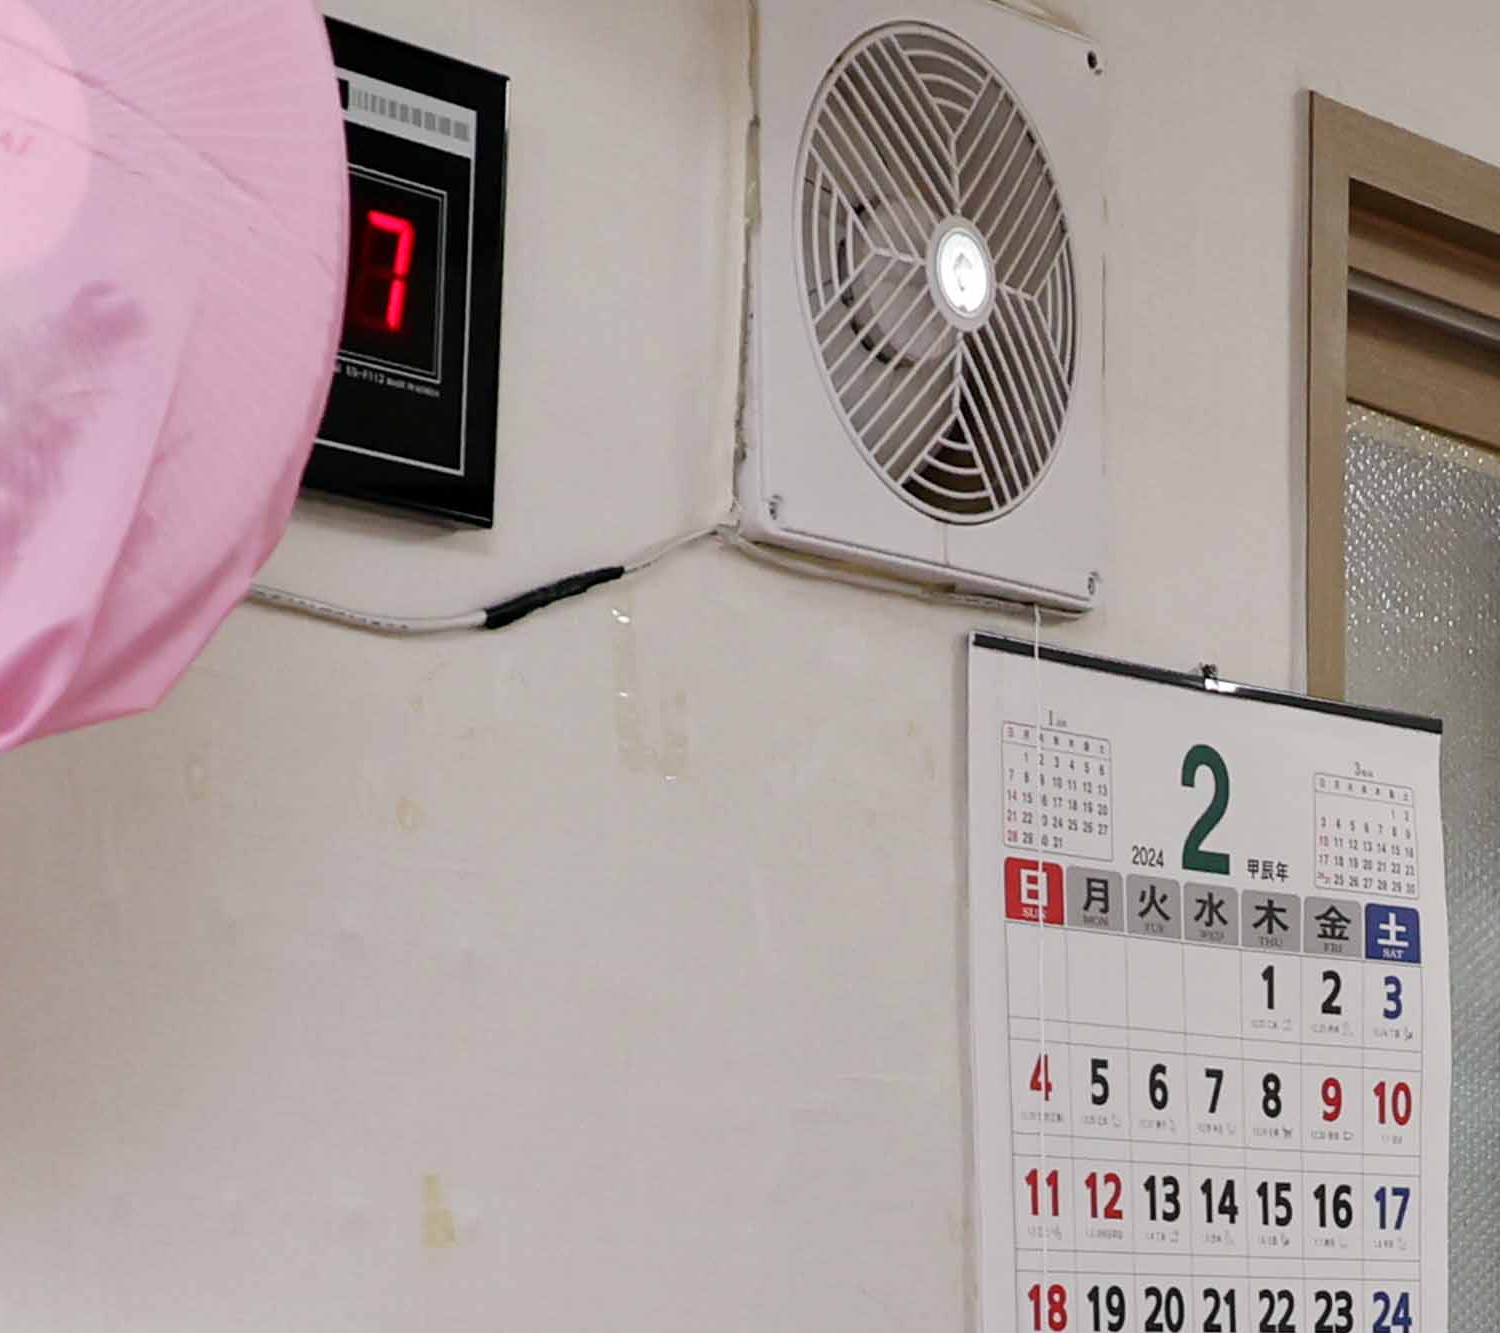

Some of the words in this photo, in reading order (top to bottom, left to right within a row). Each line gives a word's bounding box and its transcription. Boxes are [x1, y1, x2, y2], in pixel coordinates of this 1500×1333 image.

[367, 210, 416, 331] 7
[1181, 744, 1230, 875] 2
[1132, 846, 1164, 867] 2024
[1247, 859, 1289, 882] 甲辰年
[1020, 869, 1048, 906] 日
[1083, 878, 1109, 914] 月
[1138, 885, 1170, 921] 火
[1194, 892, 1228, 927] 水
[1252, 900, 1289, 934] 木
[1315, 905, 1351, 941] 金
[1377, 912, 1409, 947] 土
[1383, 949, 1403, 958] SAT
[1262, 966, 1274, 1009] 1
[1321, 970, 1341, 1015] 2
[1383, 976, 1402, 1019] 3
[1030, 1055, 1052, 1101] 4
[1091, 1059, 1109, 1105] 5
[1149, 1064, 1168, 1110] 6
[1205, 1068, 1223, 1113] 7
[1263, 1073, 1281, 1118] 8
[1322, 1078, 1342, 1122] 9
[1373, 1082, 1412, 1126] 10
[1025, 1168, 1059, 1216] 11
[1085, 1172, 1123, 1219] 12
[1144, 1176, 1180, 1222] 13
[1201, 1178, 1238, 1224] 14
[1257, 1182, 1292, 1226] 15
[1314, 1184, 1352, 1228] 16
[1374, 1187, 1410, 1230] 17
[1028, 1284, 1067, 1332] 18
[1087, 1286, 1125, 1332] 19
[1145, 1286, 1184, 1333] 20
[1203, 1288, 1236, 1333] 21
[1259, 1289, 1295, 1333] 22
[1373, 1291, 1412, 1333] 24
